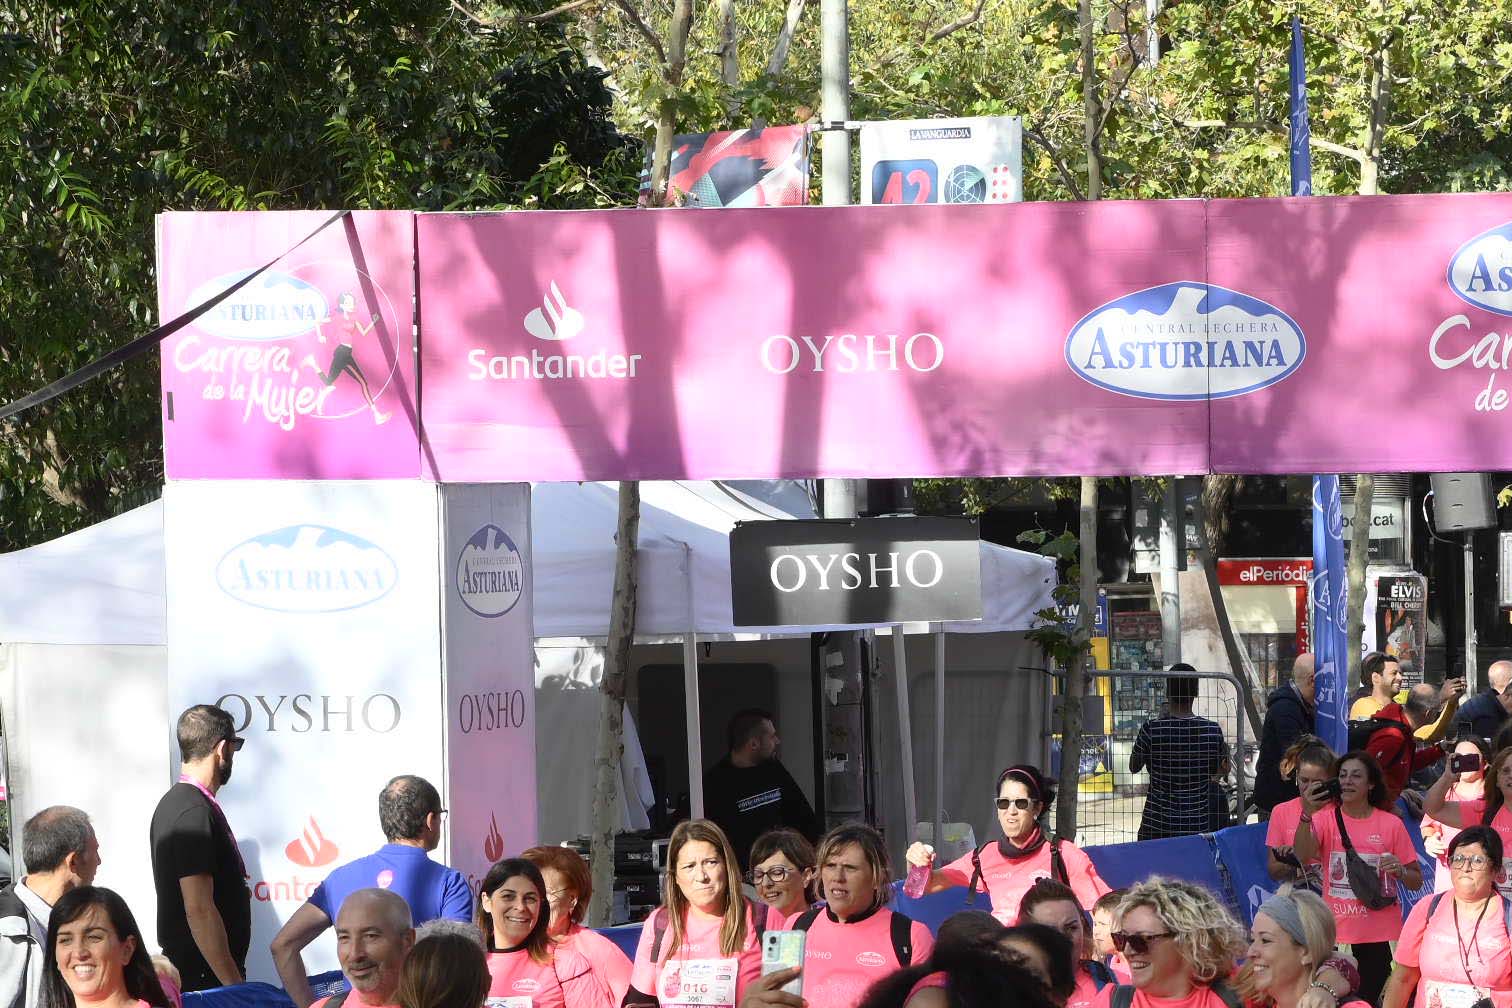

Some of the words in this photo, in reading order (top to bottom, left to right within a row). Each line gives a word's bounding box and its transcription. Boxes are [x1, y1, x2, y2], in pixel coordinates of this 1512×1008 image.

[1203, 321, 1280, 334] LECHERA
[174, 335, 291, 388] Carrera
[468, 348, 642, 381] Santander
[759, 331, 945, 375] OYSHO
[1083, 325, 1288, 369] ASTURIANA
[202, 373, 226, 400] de
[230, 373, 246, 401] la
[242, 369, 336, 432] Mujer
[1474, 374, 1509, 412] de
[233, 558, 386, 592] ASTURIANA
[461, 559, 520, 596] ASTURIANA
[769, 548, 944, 594] OYSHO
[1390, 585, 1422, 598] ELVIS
[214, 694, 401, 734] OYSHO
[459, 688, 526, 734] OYSHO
[1333, 903, 1368, 915] SUMA
[683, 983, 708, 993] 016
